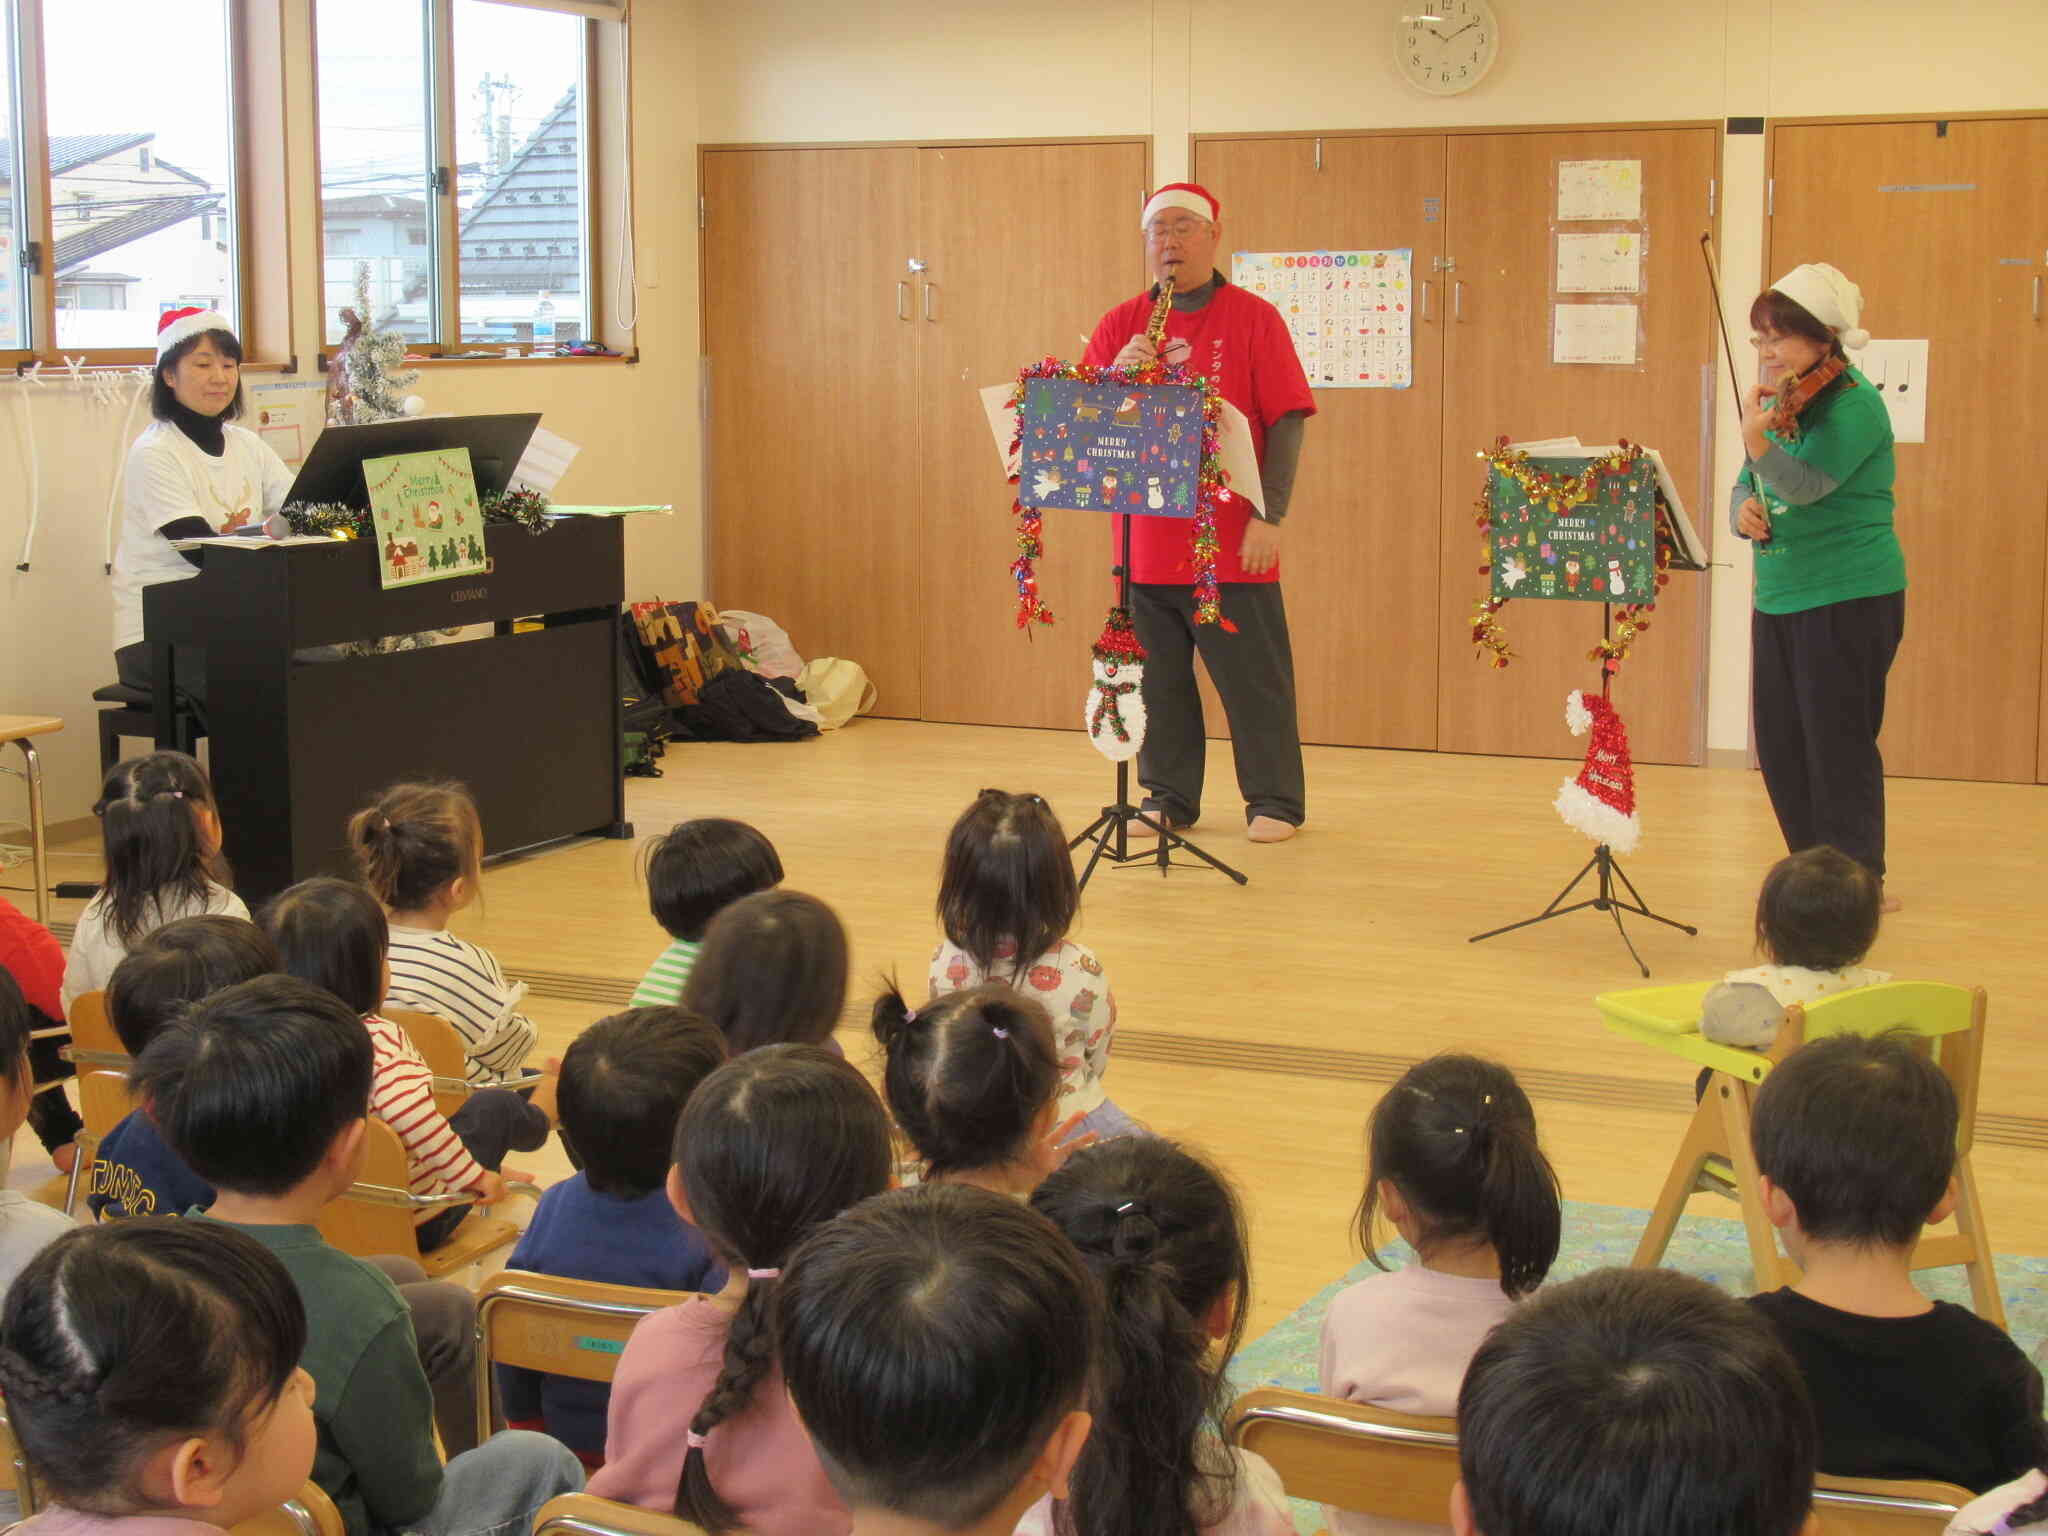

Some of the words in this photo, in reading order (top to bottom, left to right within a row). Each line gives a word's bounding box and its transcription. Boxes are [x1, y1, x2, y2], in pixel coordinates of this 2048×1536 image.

[1097, 436, 1127, 447] MERRY
[1086, 447, 1137, 459] CHRISTMAS
[1557, 518, 1586, 528] MERRY
[1547, 530, 1596, 541] CHRISTMAS
